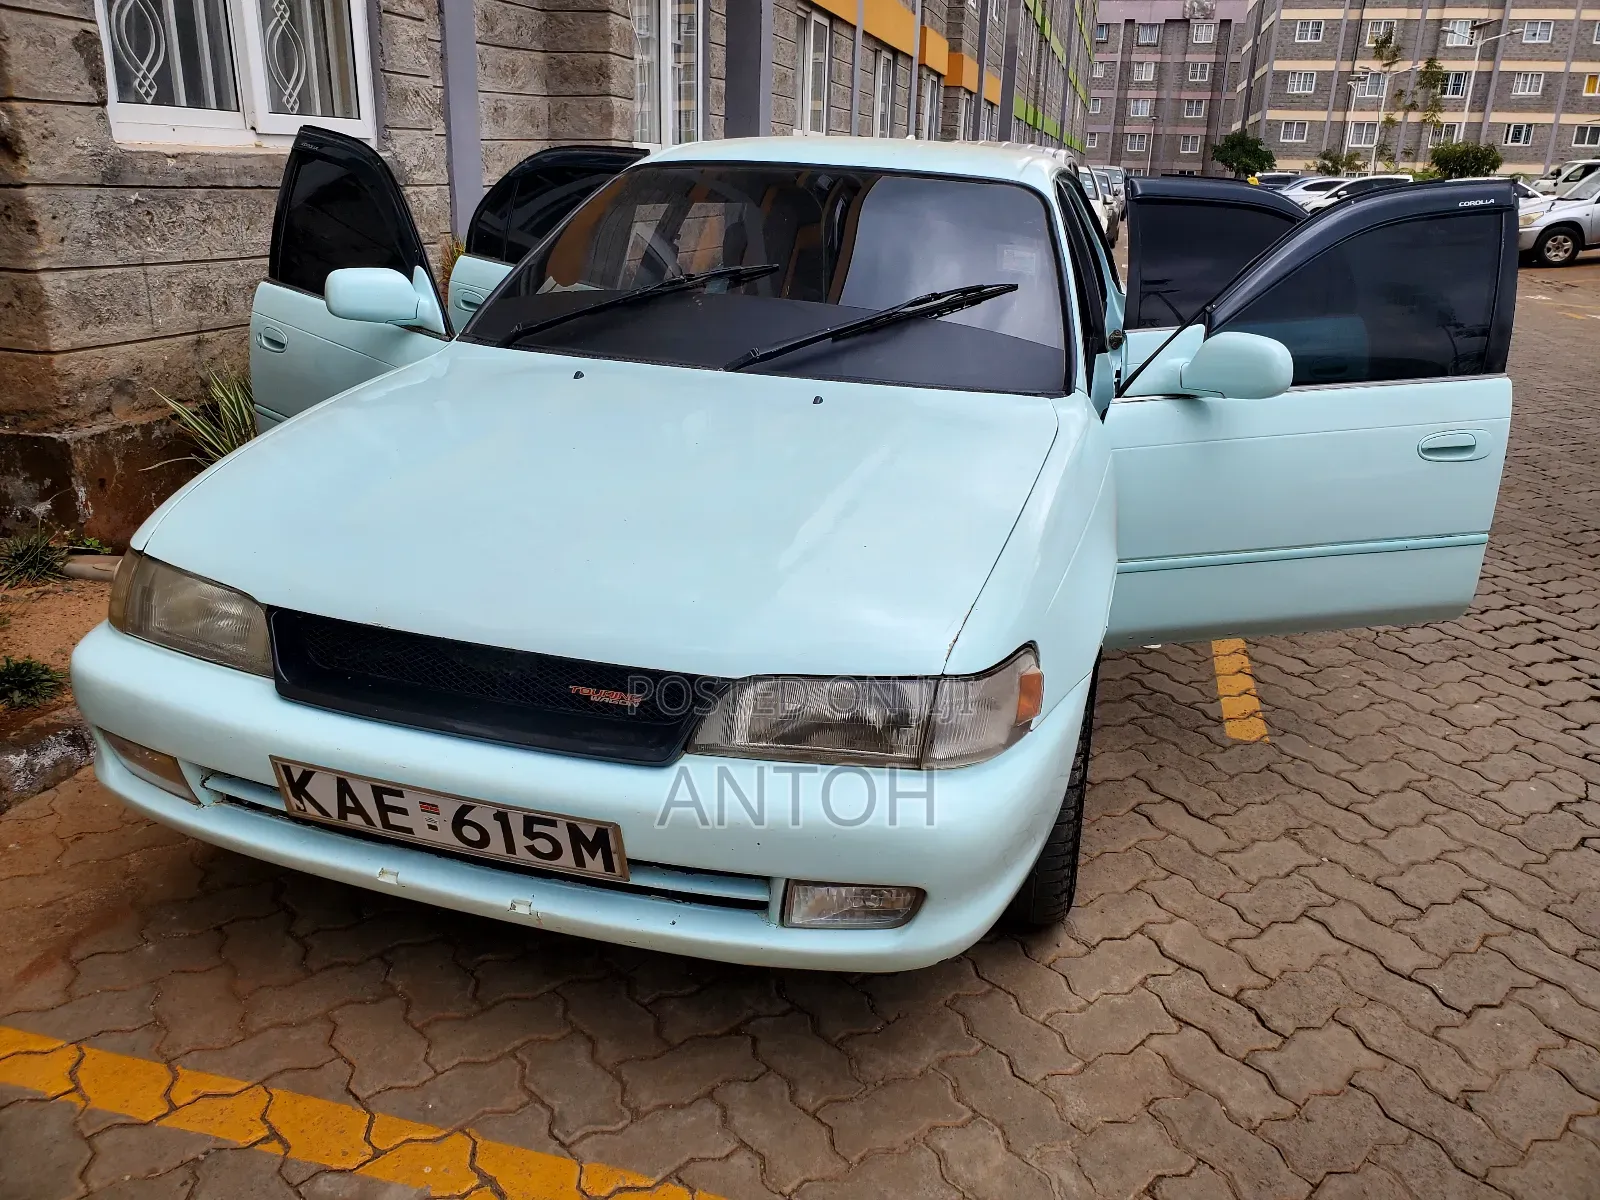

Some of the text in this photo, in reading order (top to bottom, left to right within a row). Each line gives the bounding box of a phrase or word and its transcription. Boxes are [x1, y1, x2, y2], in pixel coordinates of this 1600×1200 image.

[1458, 198, 1495, 207] COROLLA
[281, 764, 617, 873] KAE 615M
